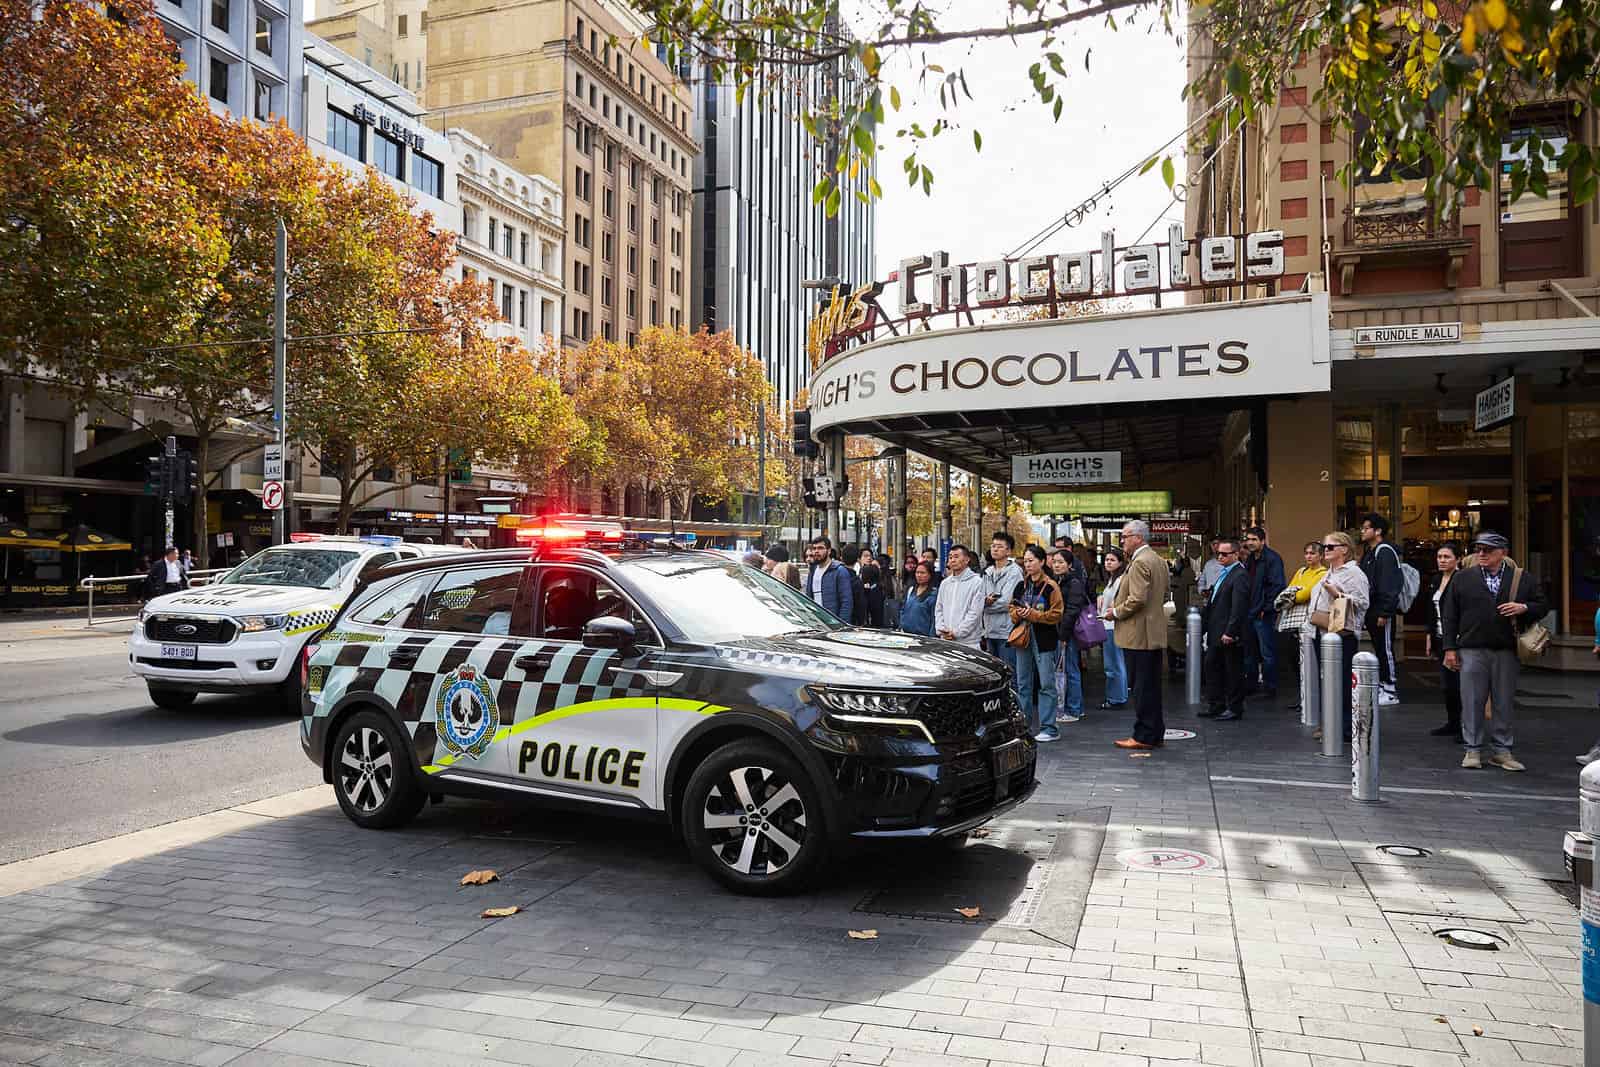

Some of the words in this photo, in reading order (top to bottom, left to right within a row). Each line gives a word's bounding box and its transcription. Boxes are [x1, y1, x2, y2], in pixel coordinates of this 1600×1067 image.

[899, 222, 1286, 316] Chocolates
[1375, 328, 1419, 341] RUNDLE
[1424, 327, 1454, 339] MALL
[811, 369, 877, 416] AIGH'S
[889, 340, 1250, 395] CHOCOLATES
[1478, 383, 1511, 415] HAIGH'S
[1028, 457, 1104, 472] HAIGH'S
[1028, 471, 1104, 480] CHOCOLATES
[1319, 470, 1330, 482] 2
[1152, 522, 1190, 531] MASSAGE
[169, 598, 239, 607] POLICE
[518, 740, 647, 788] POLICE
